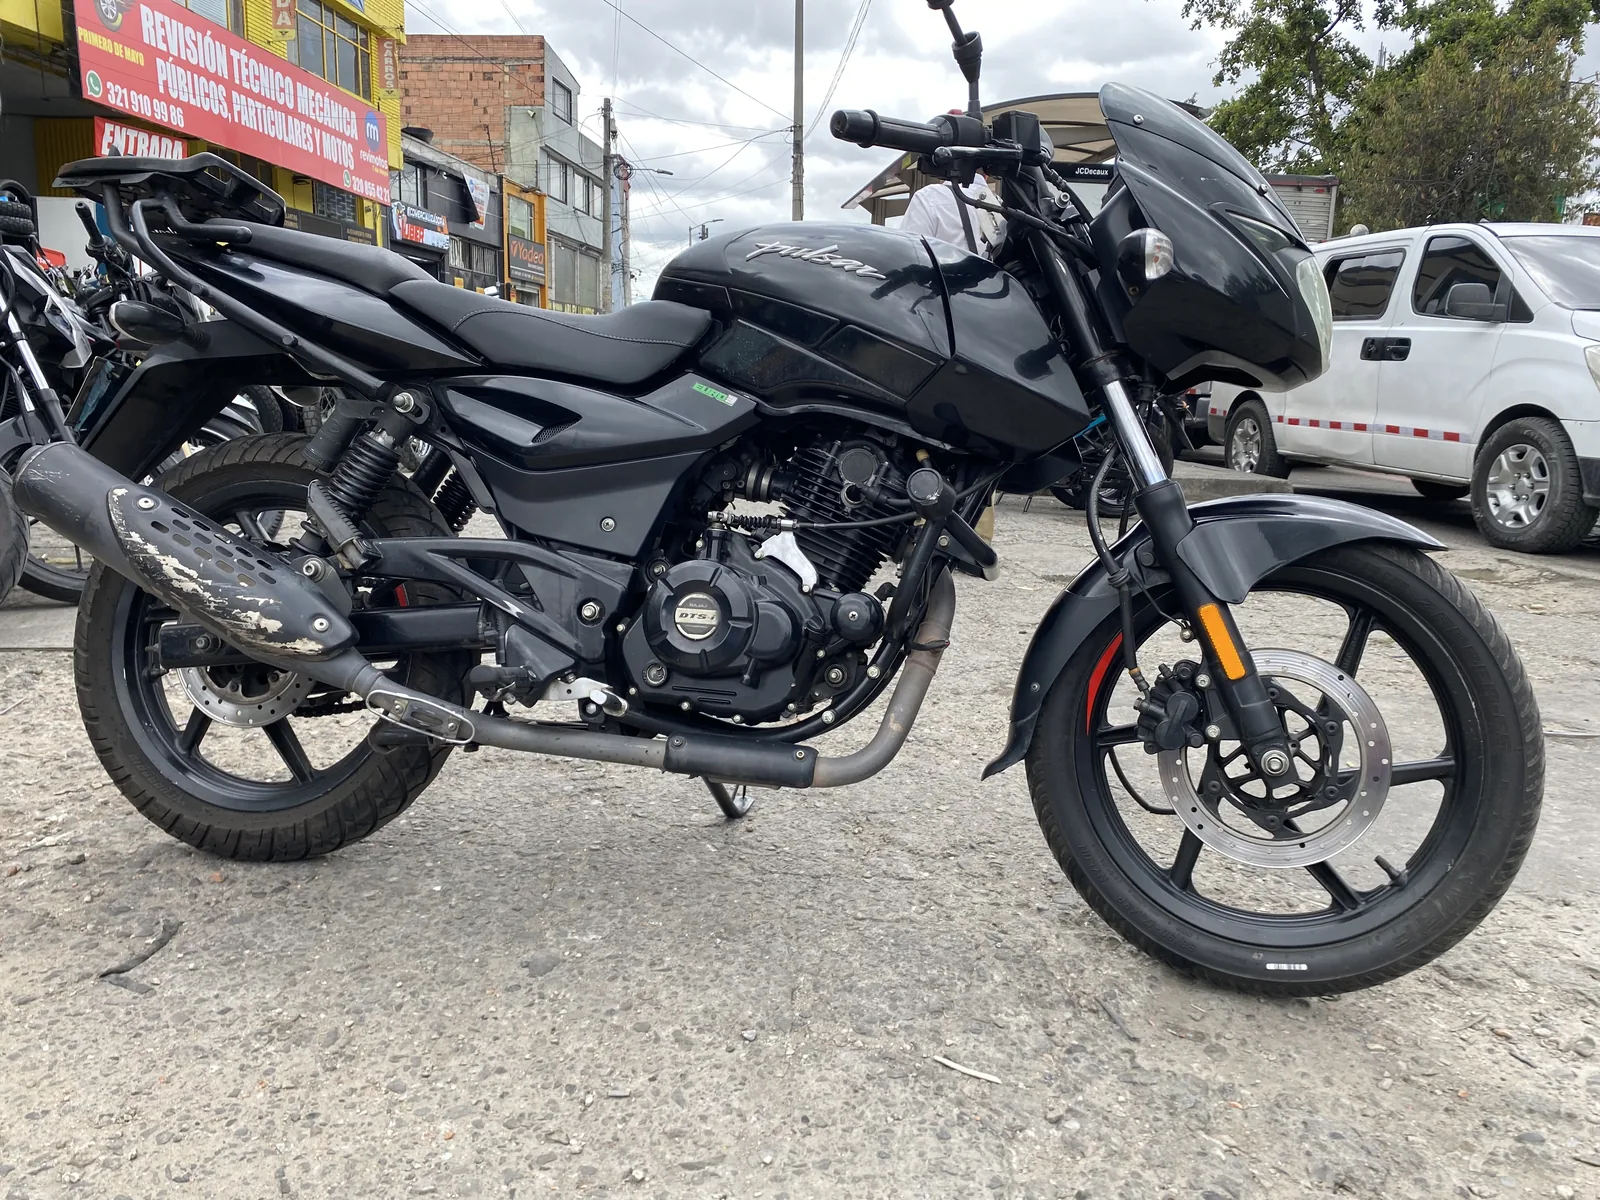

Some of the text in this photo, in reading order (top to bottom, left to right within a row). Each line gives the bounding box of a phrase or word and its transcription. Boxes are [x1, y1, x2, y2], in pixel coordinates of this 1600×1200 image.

[78, 26, 144, 66] PRIMERO DE MAYO
[383, 41, 395, 88] CARROS
[140, 3, 358, 140] REVISIÓN TÉCNICO MECÁNICA
[106, 81, 184, 128] 321 910 99 86
[156, 56, 354, 170] PÚBLICOS, PARTICULARES Y MOTOS
[101, 122, 183, 160] ENTRADA
[352, 176, 364, 194] 320
[1075, 167, 1109, 176] JCDecaux
[518, 240, 544, 265] Yadea
